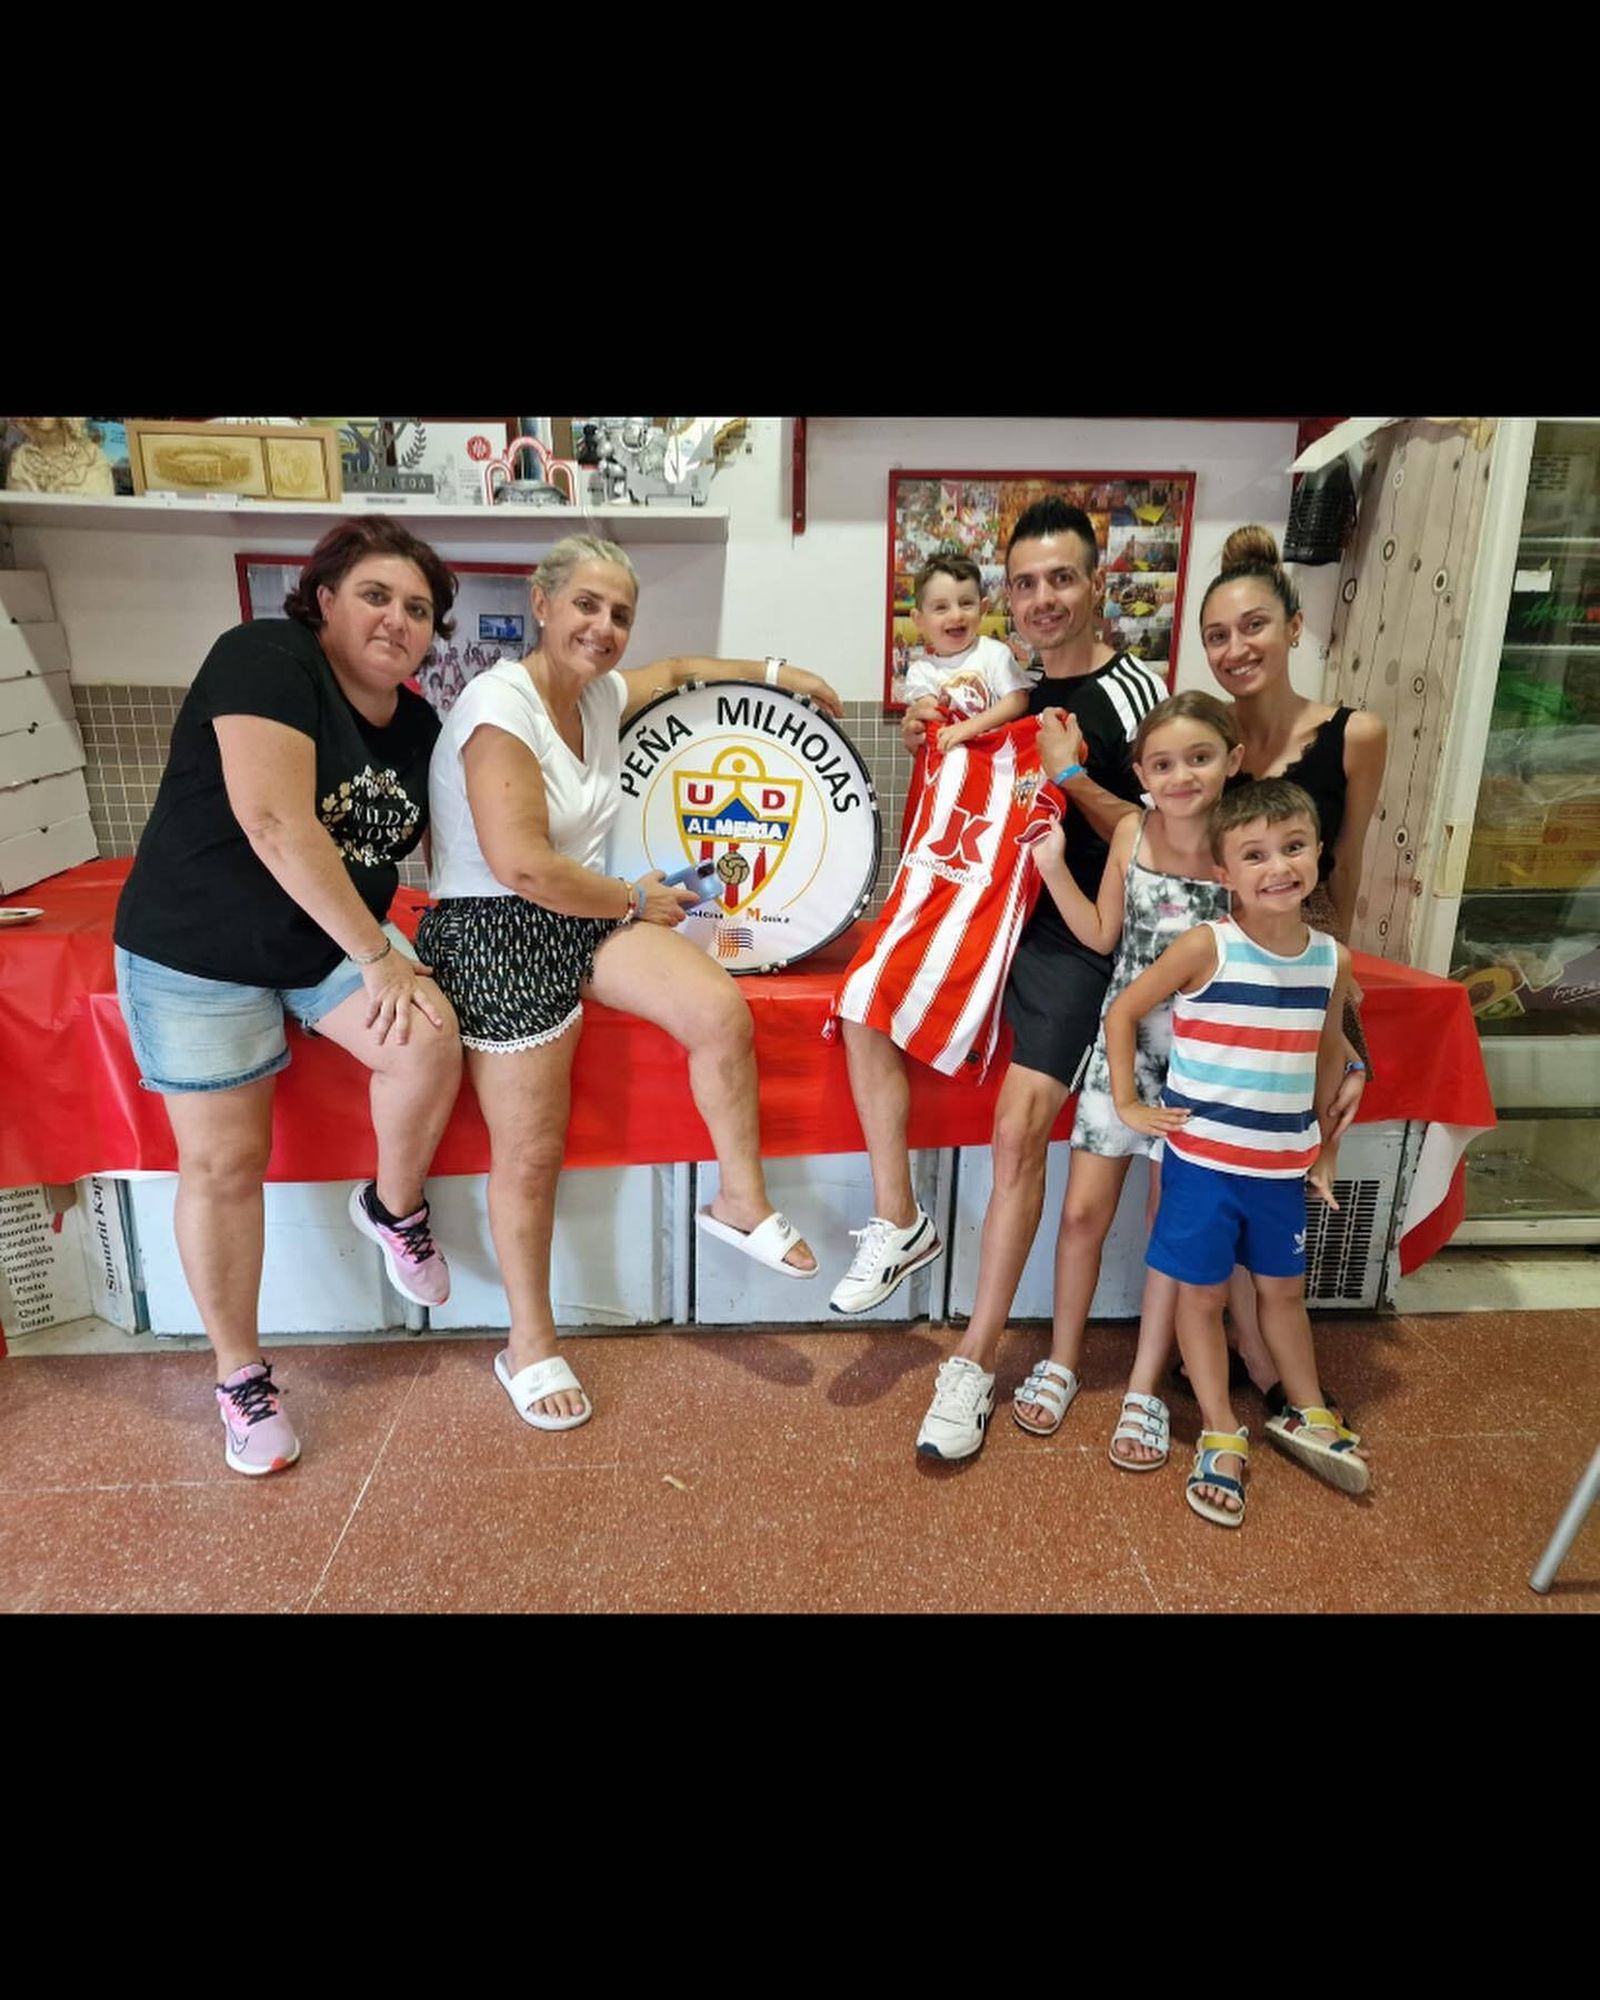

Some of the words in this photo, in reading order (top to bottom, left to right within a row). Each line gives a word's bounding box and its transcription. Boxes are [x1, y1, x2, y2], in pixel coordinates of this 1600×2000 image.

[620, 714, 694, 799] PEÑA
[716, 696, 861, 815] MILHOJAS
[687, 783, 714, 805] U
[761, 789, 786, 810] D
[92, 1176, 104, 1216] Kap
